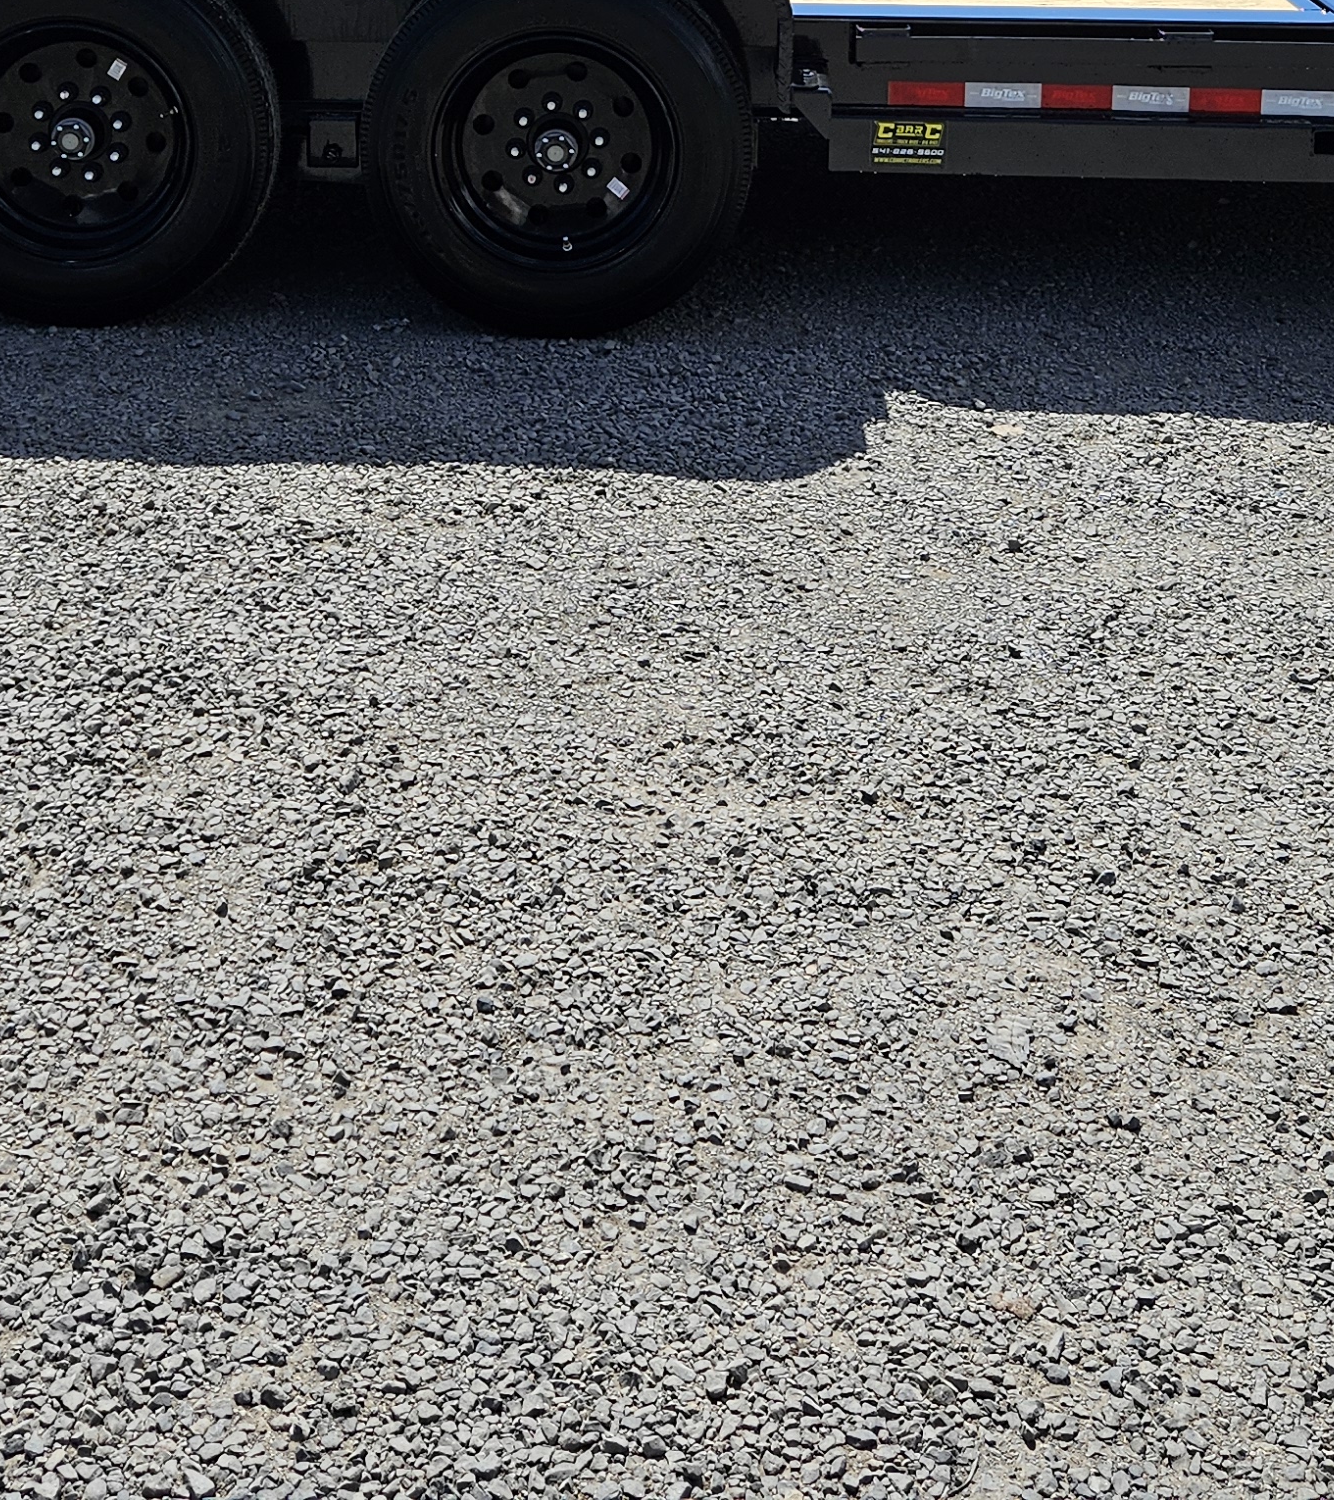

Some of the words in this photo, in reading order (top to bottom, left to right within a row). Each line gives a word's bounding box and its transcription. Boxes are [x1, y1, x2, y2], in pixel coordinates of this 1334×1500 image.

[980, 87, 1026, 100] BigTex
[1128, 91, 1174, 106] BigTex
[1278, 95, 1323, 108] BigTex
[877, 122, 895, 138] C
[895, 124, 924, 135] BAR
[924, 123, 943, 139] C
